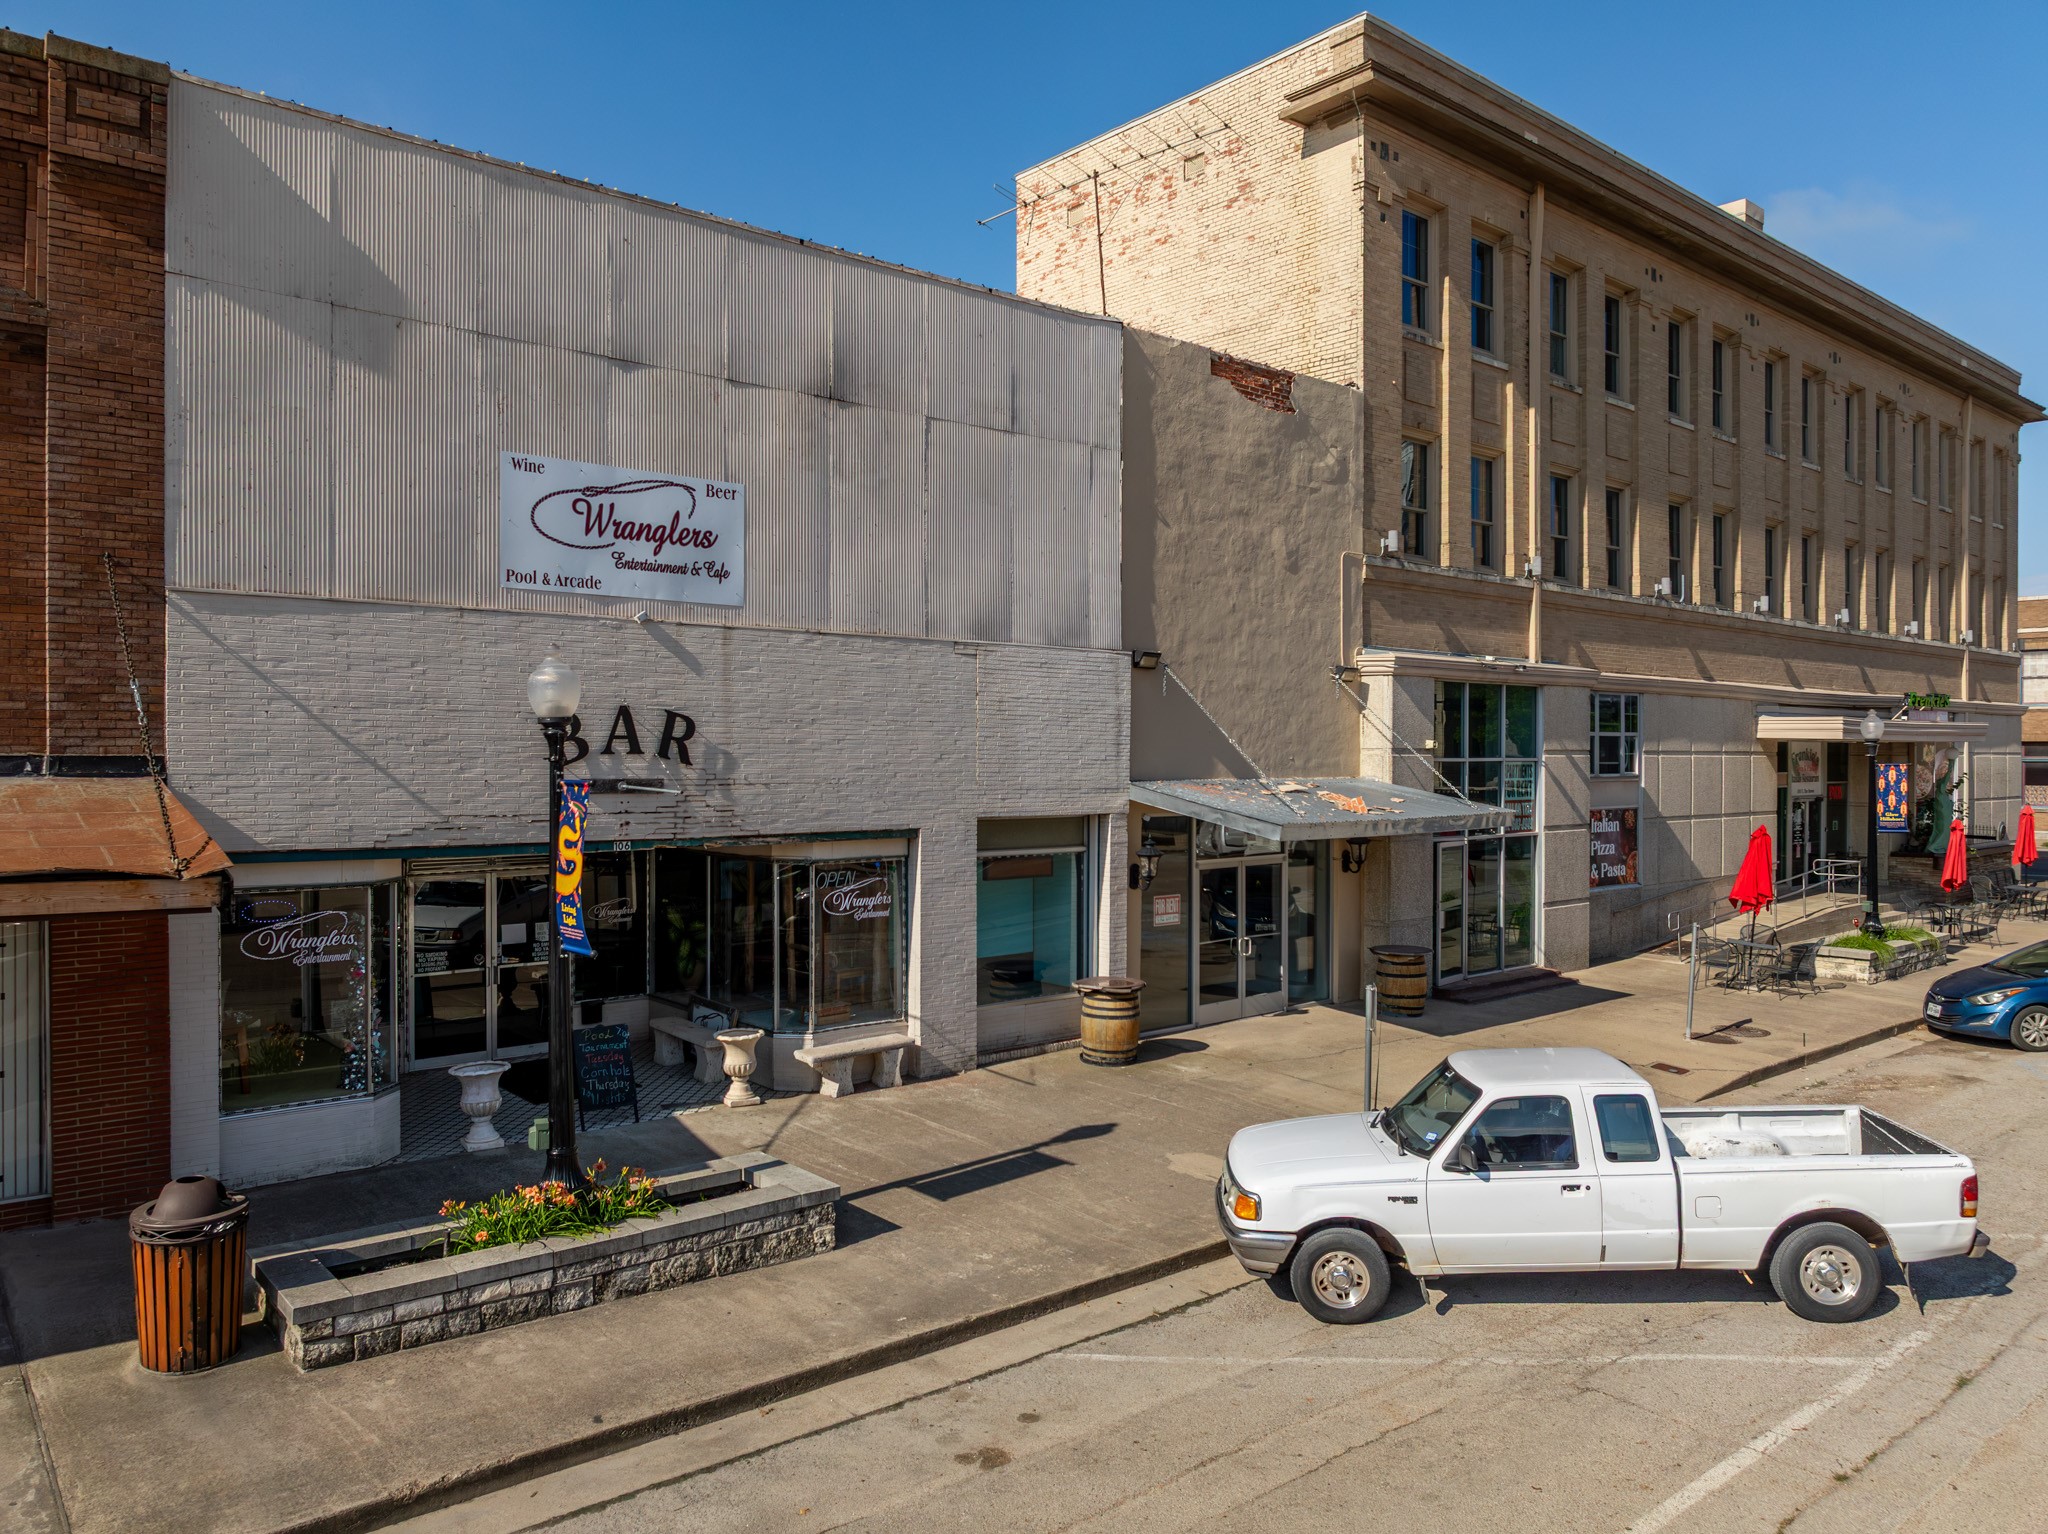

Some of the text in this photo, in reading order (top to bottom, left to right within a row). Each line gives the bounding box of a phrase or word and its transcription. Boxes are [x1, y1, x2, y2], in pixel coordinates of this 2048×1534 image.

[511, 456, 546, 474] Wine
[705, 484, 738, 501] Beer
[571, 498, 719, 556] Wranglers
[611, 552, 731, 585] Entertainment & Cafe
[505, 568, 603, 590] Pool & Arcade
[558, 704, 696, 767] BAR
[1590, 817, 1620, 833] Italian
[615, 841, 630, 851] 106
[1590, 840, 1616, 856] Pizza
[1590, 862, 1627, 879] & Pasta
[815, 870, 857, 890] OPEN
[833, 890, 892, 913] Wranglers
[1155, 897, 1179, 915] FOR RENT
[292, 949, 353, 967] Entertainment
[585, 1051, 624, 1065] Tuesday
[585, 1077, 630, 1092] Thursday
